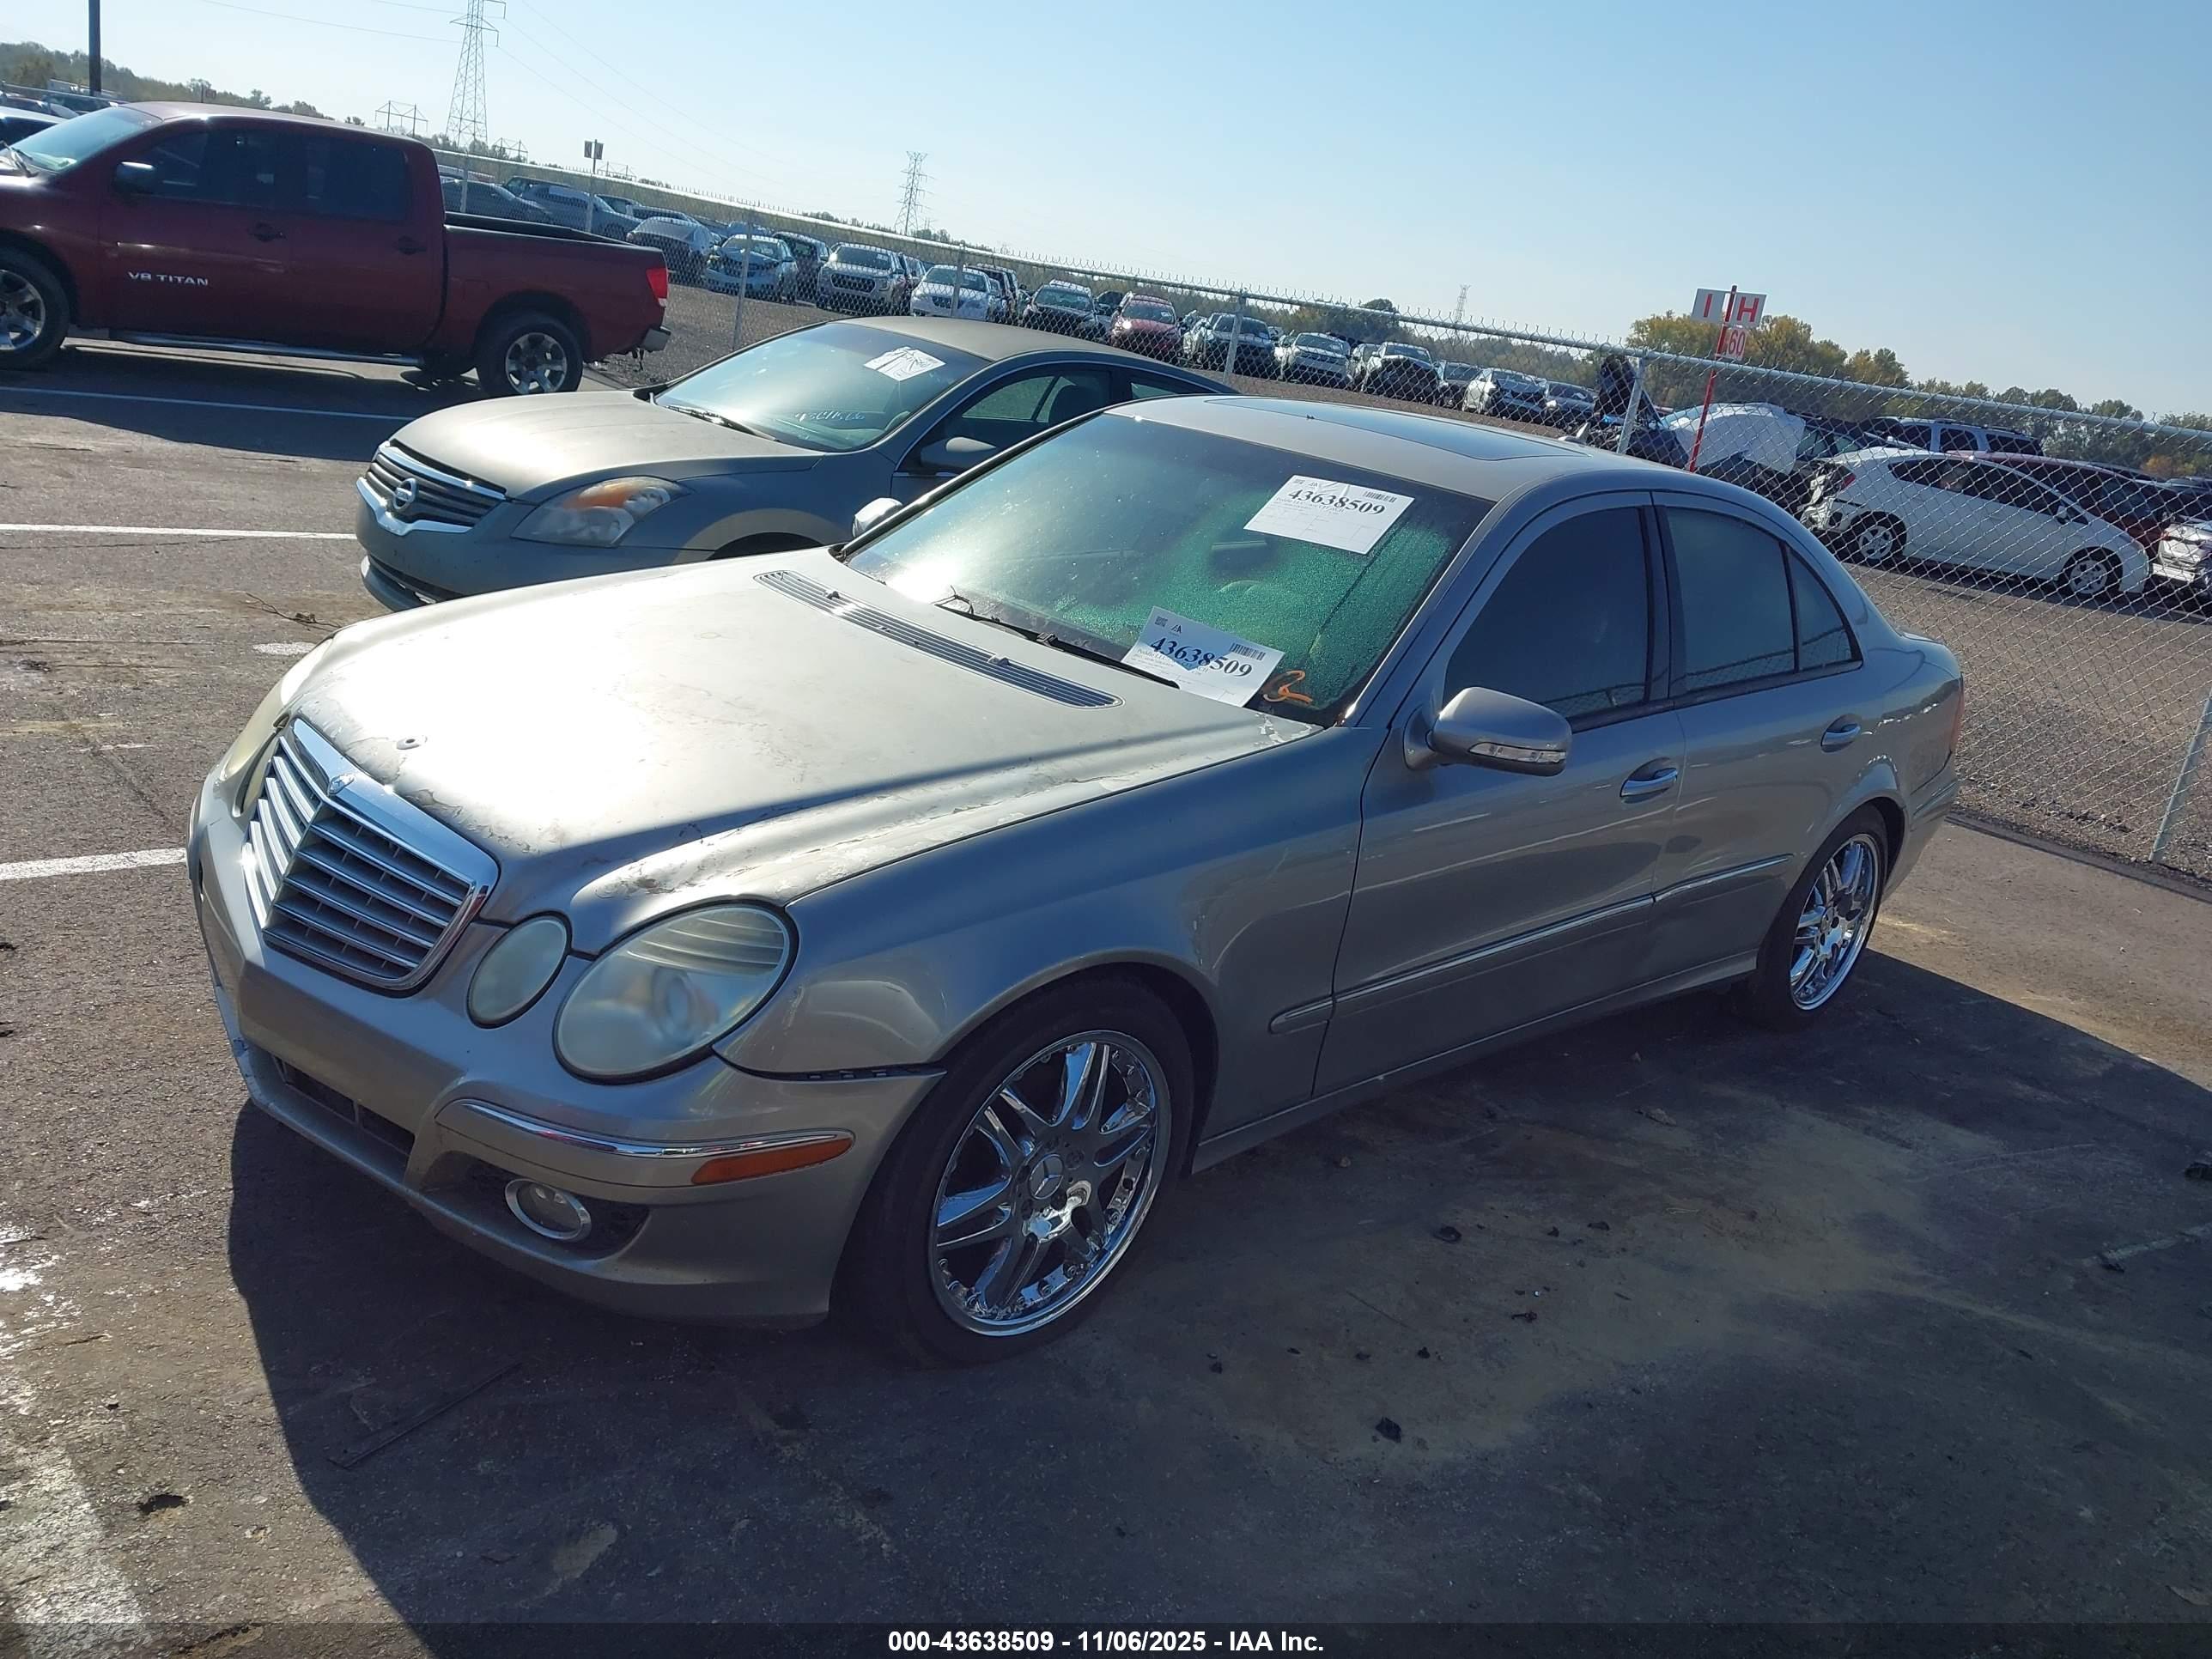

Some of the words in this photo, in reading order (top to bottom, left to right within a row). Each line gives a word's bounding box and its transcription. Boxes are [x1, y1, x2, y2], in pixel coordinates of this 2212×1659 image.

[128, 271, 152, 281] V8
[156, 274, 209, 286] TITAN
[1736, 296, 1759, 323] H
[1728, 329, 1746, 356] 60
[1287, 489, 1386, 515] 43638509
[1150, 637, 1253, 677] 43638509
